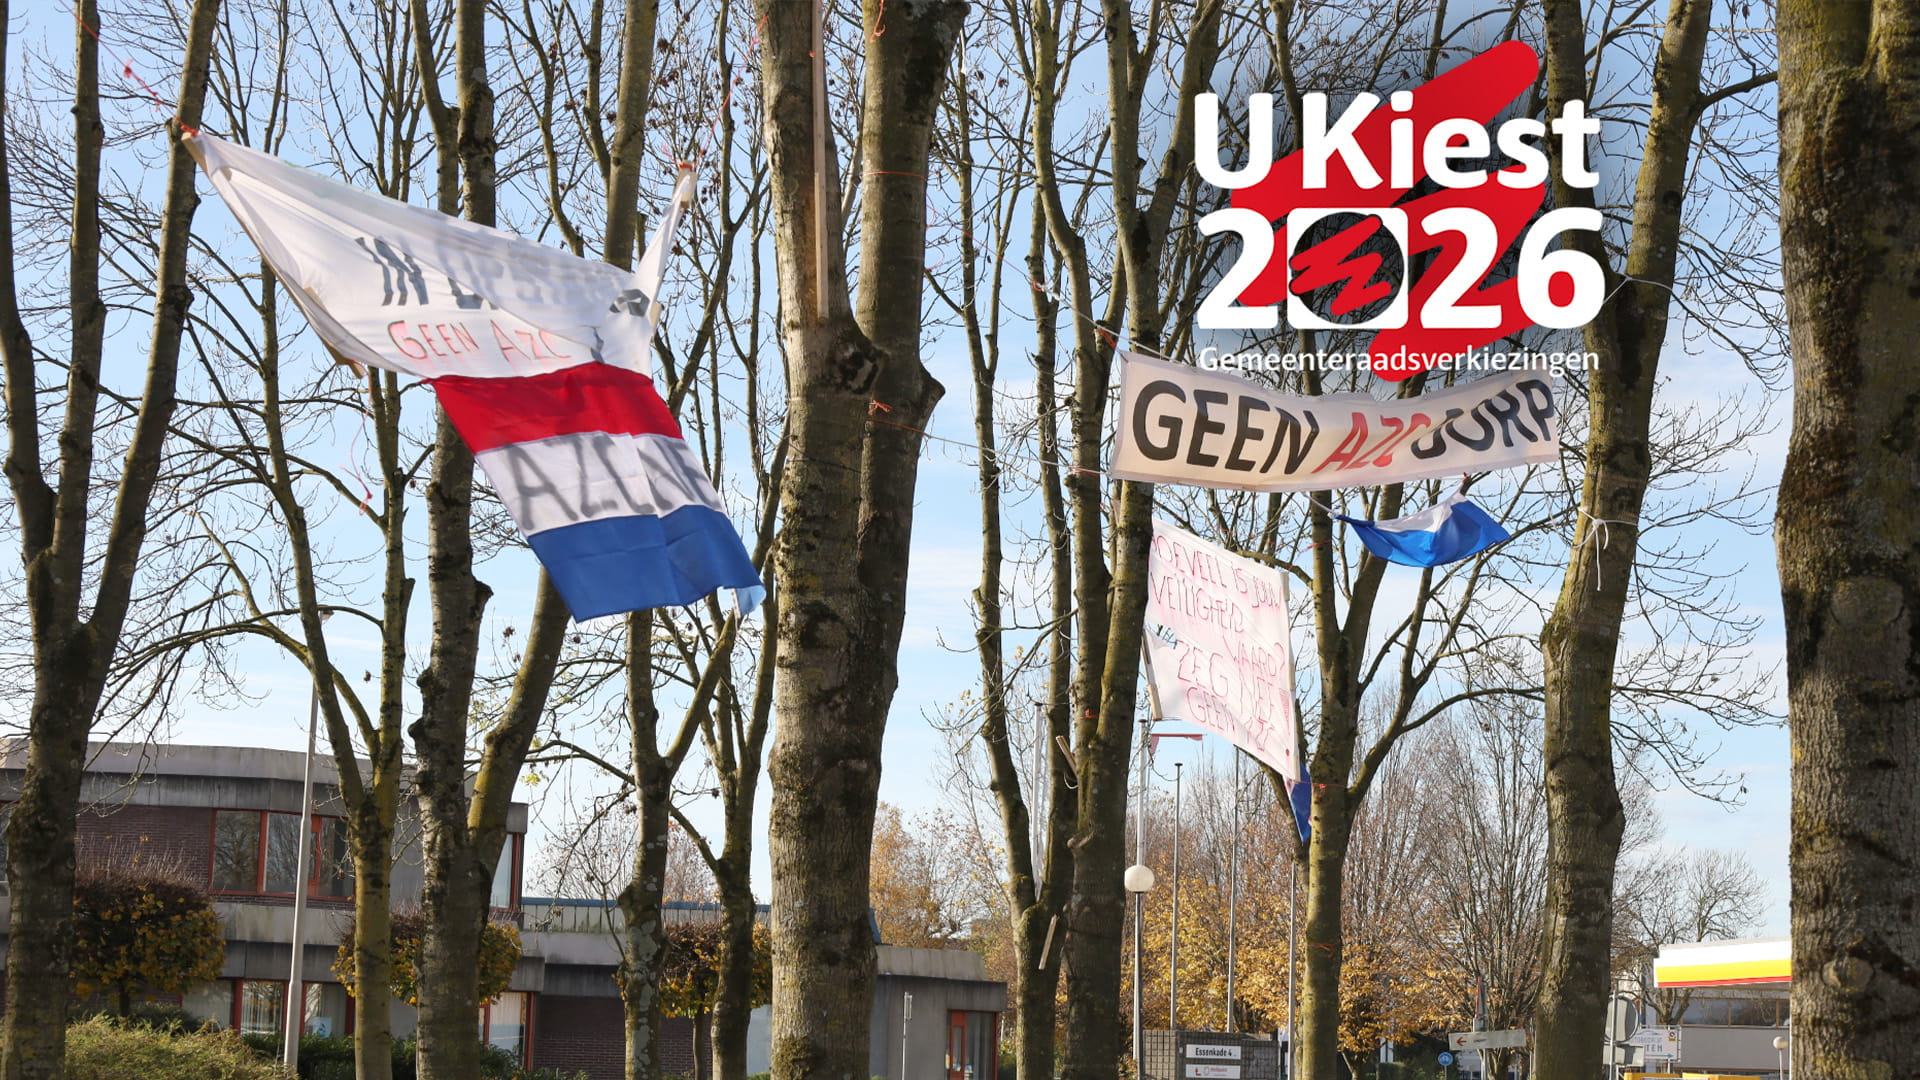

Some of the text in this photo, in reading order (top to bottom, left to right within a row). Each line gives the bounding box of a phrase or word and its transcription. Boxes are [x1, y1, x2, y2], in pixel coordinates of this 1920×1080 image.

[387, 319, 571, 362] GEEN AZC
[1132, 379, 1319, 474] GEEN
[1178, 640, 1229, 698] ZEG
[1195, 1047, 1233, 1057] Essenkade 4
